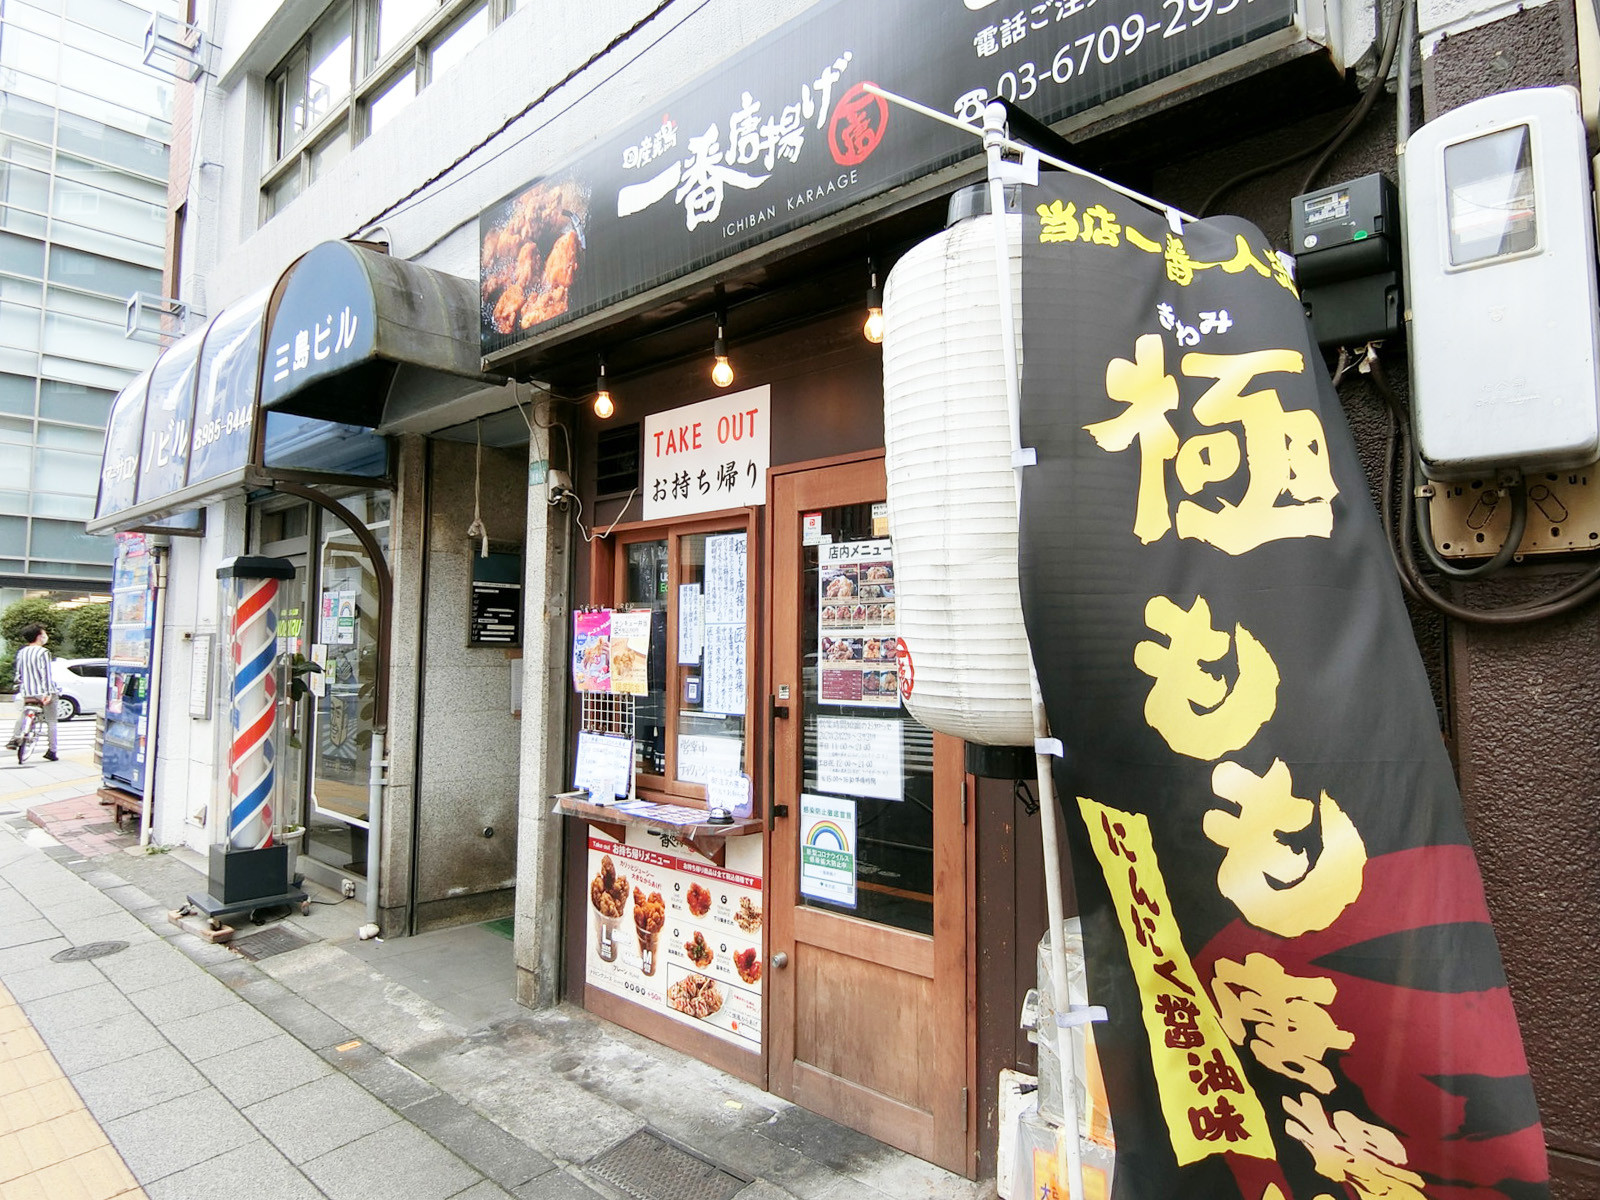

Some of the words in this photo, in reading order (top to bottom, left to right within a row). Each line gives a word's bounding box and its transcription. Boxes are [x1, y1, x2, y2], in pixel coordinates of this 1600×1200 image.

[973, 0, 1110, 58] 電話ご注
[997, 0, 1252, 104] 03-6709-29
[617, 50, 853, 232] 一番唐揚げ
[722, 206, 777, 238] ICHIBAN
[786, 169, 859, 210] KARAAGE
[273, 306, 358, 382] 三島ビル
[1156, 302, 1234, 347] きわみ
[653, 422, 702, 458] TAKE
[717, 408, 759, 445] OUT
[652, 459, 758, 502] お持ち帰り
[828, 544, 891, 559] 店内メニュー
[612, 844, 671, 866] お持ち帰りメニュー
[1100, 810, 1253, 1142] にんにく醤油味
